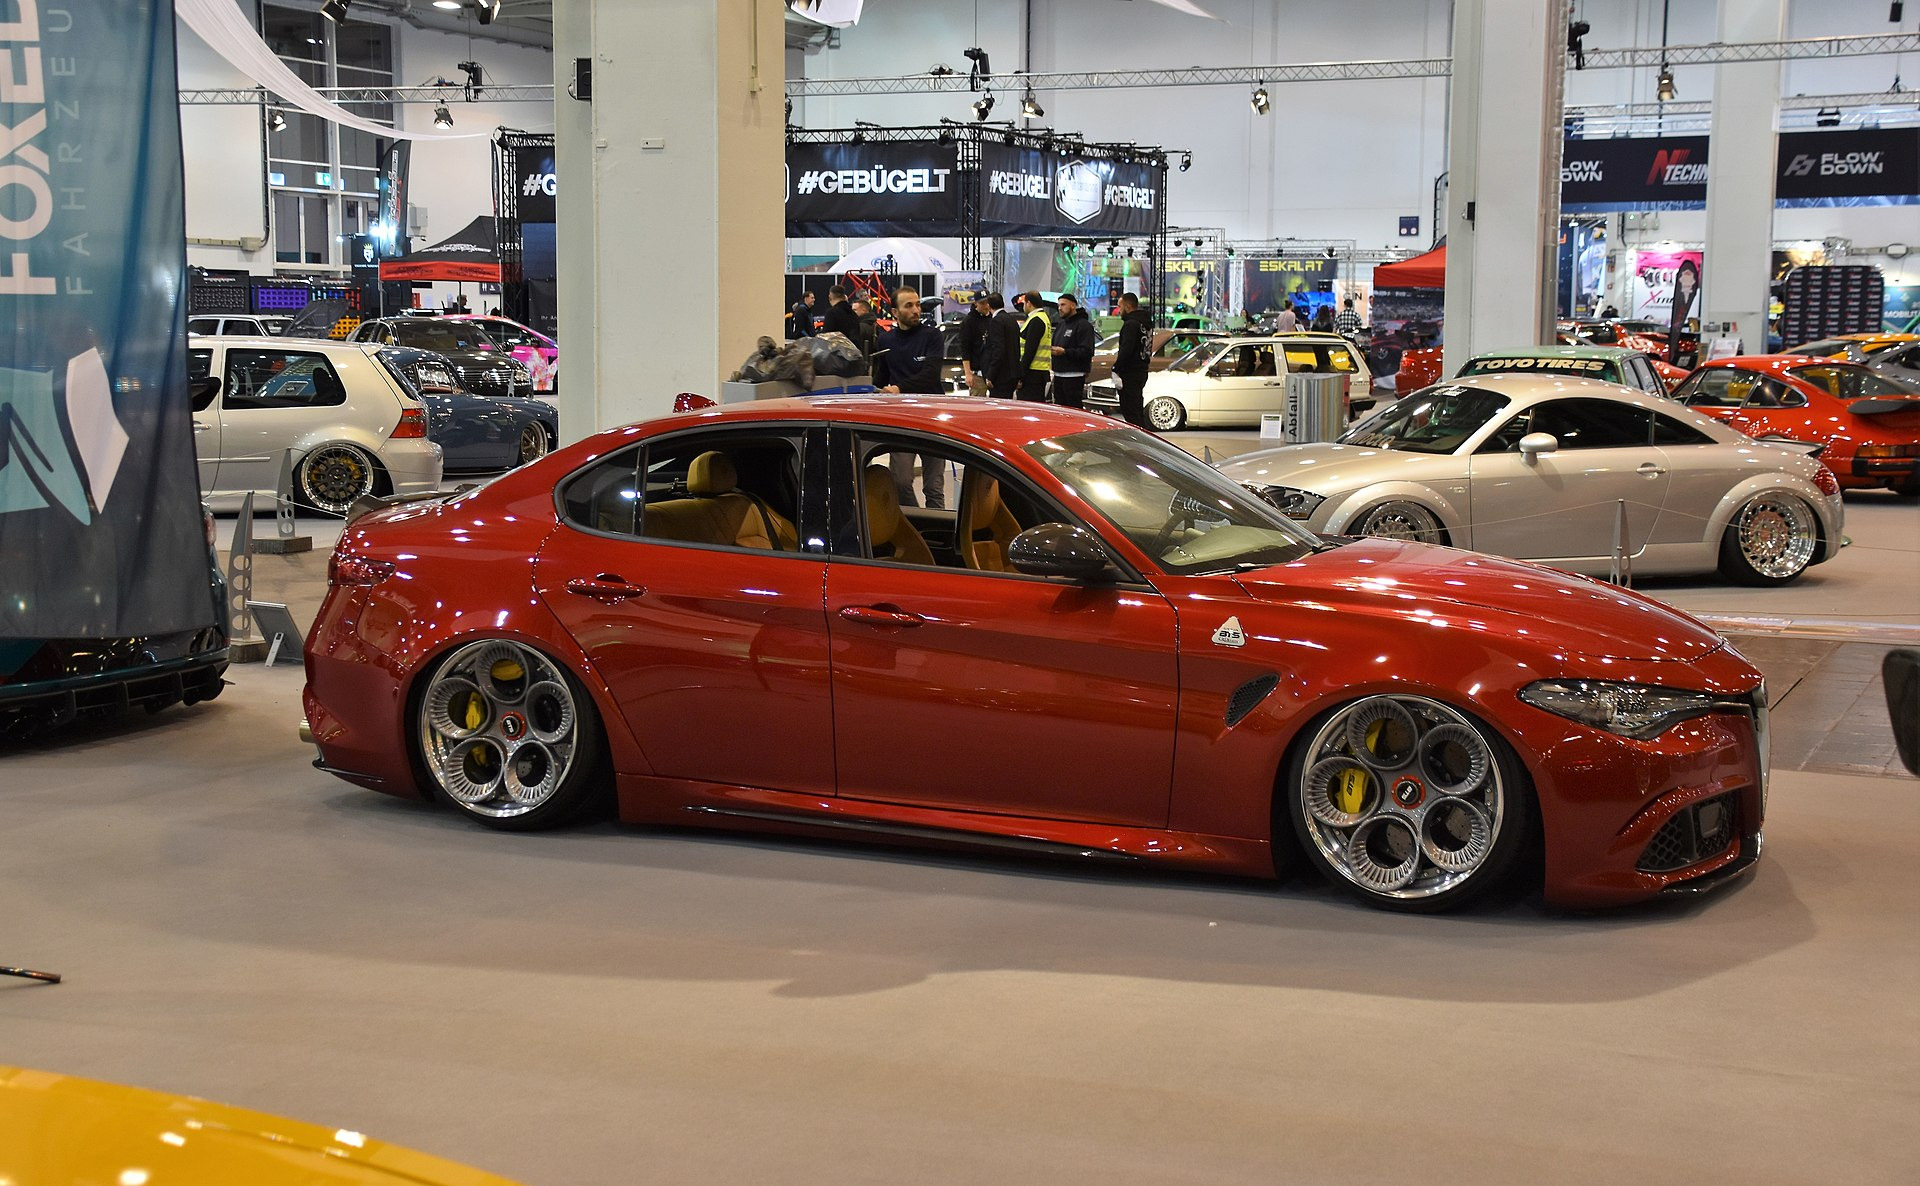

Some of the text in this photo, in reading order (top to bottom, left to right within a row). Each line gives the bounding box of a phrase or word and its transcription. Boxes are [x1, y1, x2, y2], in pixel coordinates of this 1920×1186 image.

[47, 9, 93, 295] FAHRZEU
[1821, 151, 1881, 164] FLOW
[797, 164, 951, 194] #GEBÜGELT
[1820, 162, 1884, 175] DOWN
[989, 169, 1053, 200] #GEBÜGELT
[1104, 182, 1156, 210] #GEBÜGELT
[1259, 260, 1324, 272] ESKALAT
[1475, 358, 1606, 371] TOYO TIRES
[1288, 395, 1298, 437] Abfall
